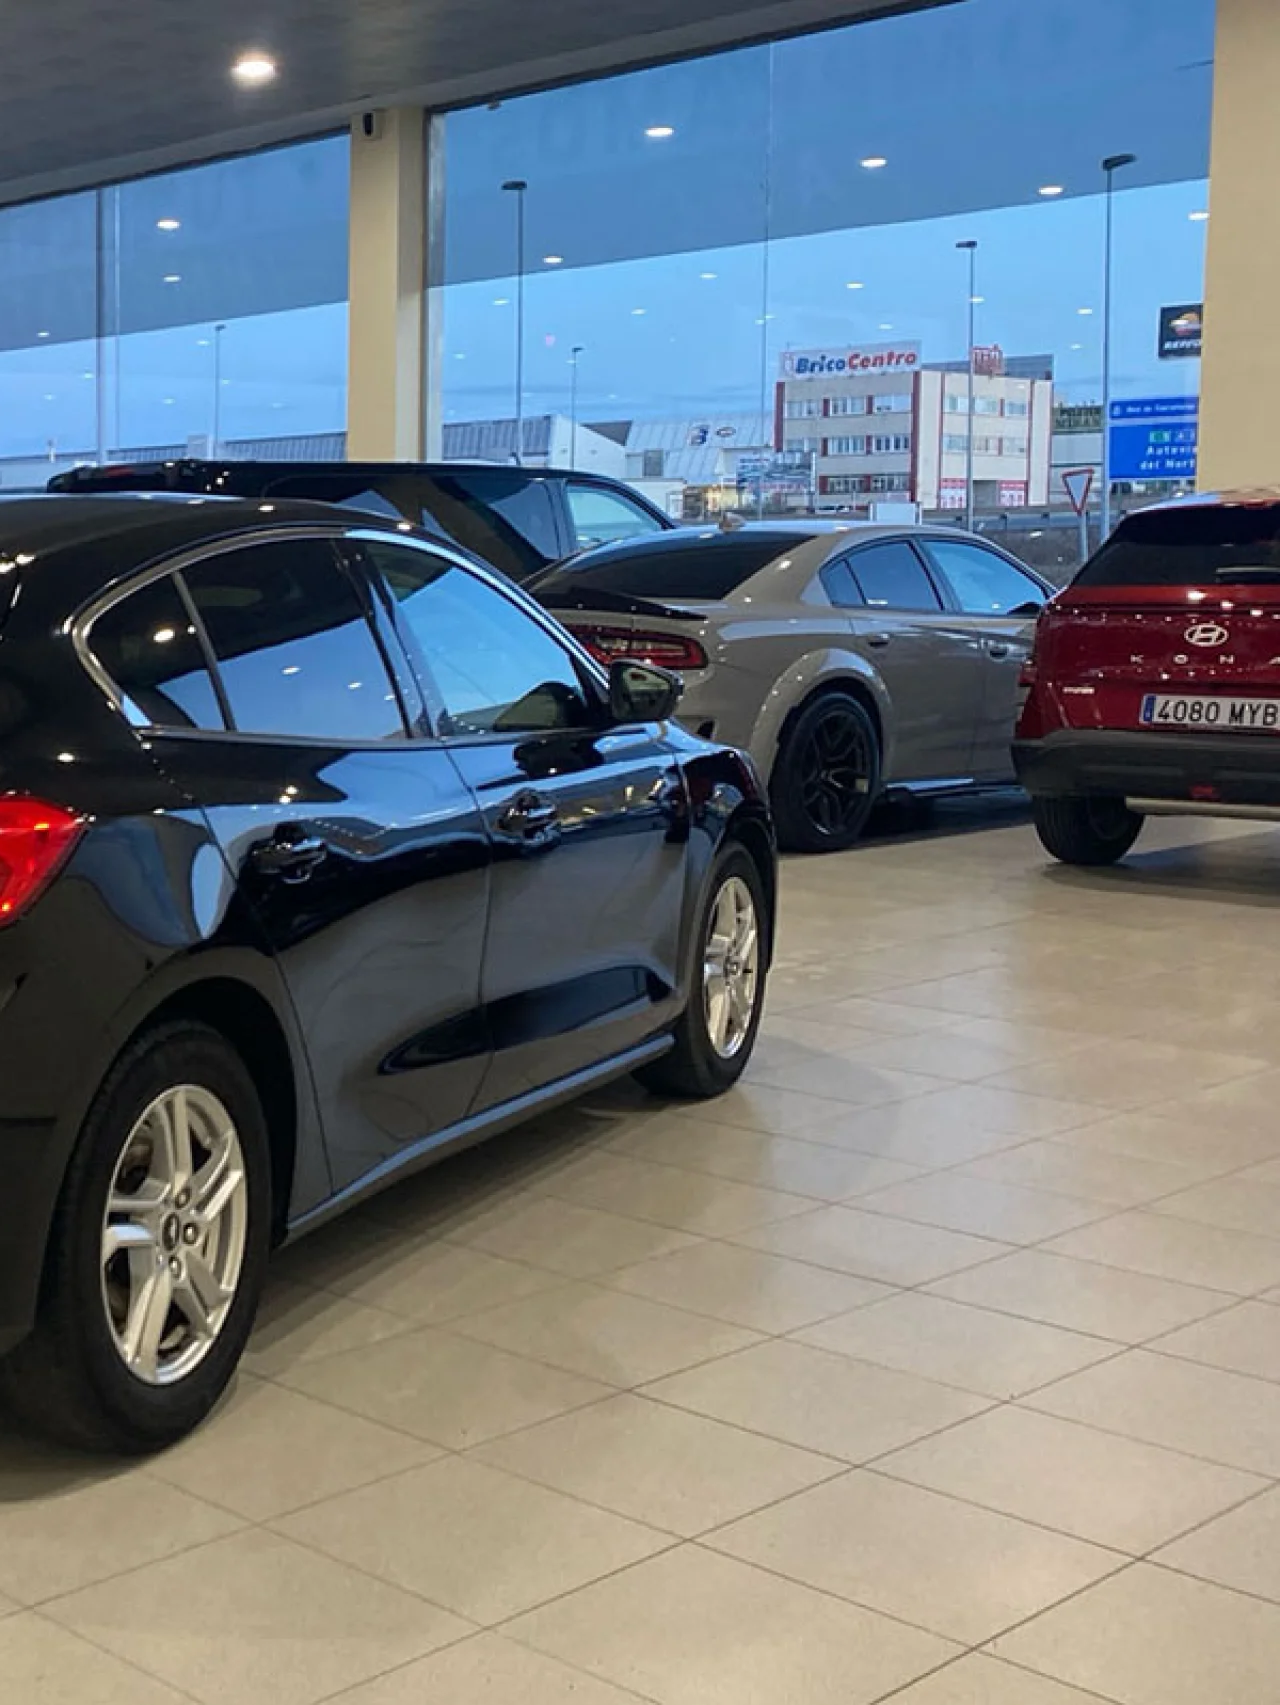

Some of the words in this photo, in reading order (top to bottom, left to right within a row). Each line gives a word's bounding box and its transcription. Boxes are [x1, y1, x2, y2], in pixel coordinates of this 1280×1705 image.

[796, 351, 918, 374] BricoCentro
[1158, 700, 1219, 722] 4080
[1229, 702, 1279, 726] MYB
